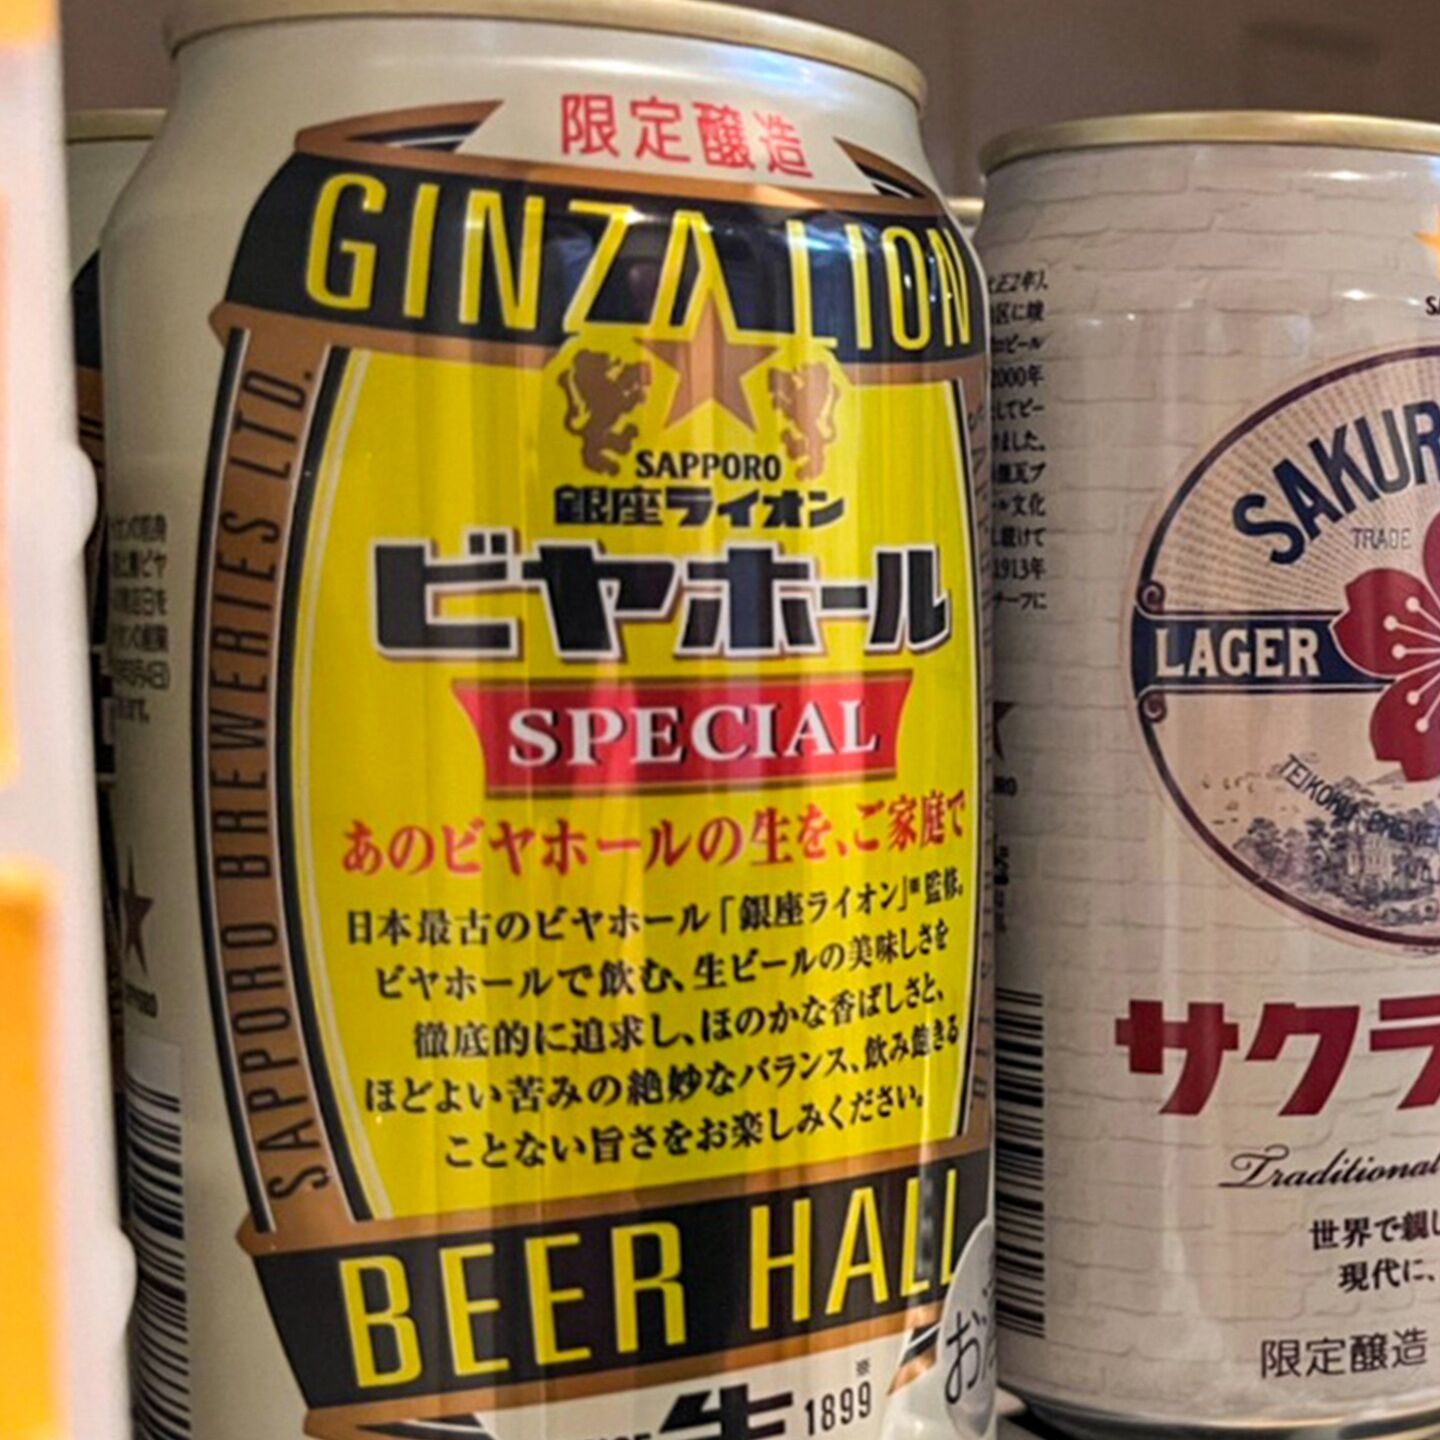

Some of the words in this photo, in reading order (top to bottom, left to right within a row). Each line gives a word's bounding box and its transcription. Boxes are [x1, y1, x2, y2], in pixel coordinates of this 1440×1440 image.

[305, 172, 738, 340] GINZA
[788, 218, 972, 353] LION
[245, 366, 314, 479] LTD.
[635, 448, 782, 482] SAPPORO
[553, 487, 847, 529] 銀座ライオン
[1352, 527, 1412, 550] TRADE
[369, 526, 952, 661] ビヤホール
[207, 509, 281, 881] BREWERIES
[1155, 627, 1321, 678] LAGER
[506, 697, 880, 768] SPECIAL
[341, 789, 966, 878] あのビヤホールの生を、ご家庭で
[375, 917, 949, 1001] ビヤホールで飲む、生ビールの美味しさを
[221, 917, 332, 1201] SAPPORO
[413, 971, 945, 1060] 徹底的に追求し、ほのかな香ばしさと、
[444, 1082, 925, 1169] ことない旨さをお楽しみください。
[337, 1221, 687, 1391] BEER
[747, 1168, 961, 1332] HALL
[805, 1380, 872, 1437] 1899
